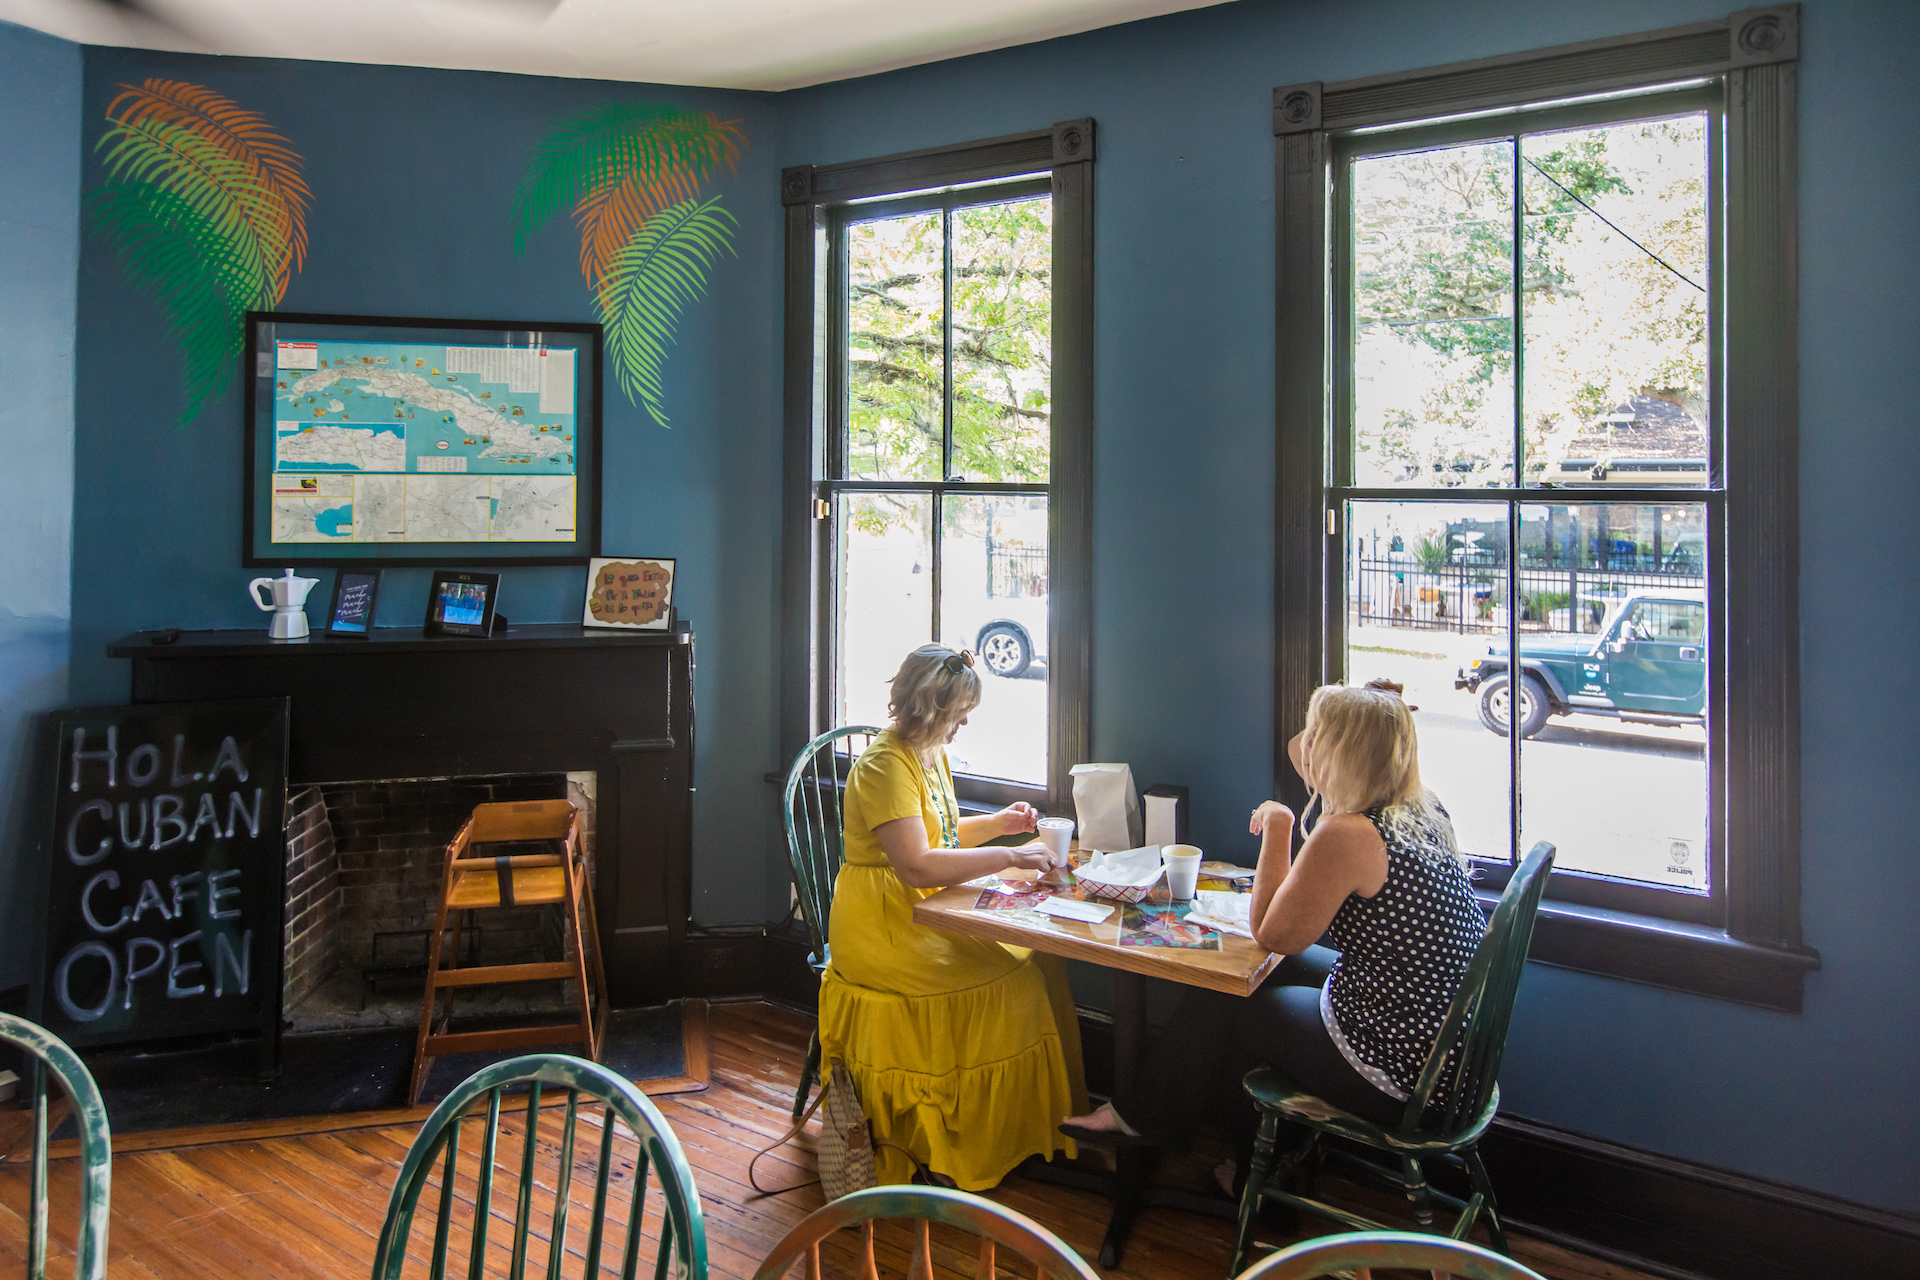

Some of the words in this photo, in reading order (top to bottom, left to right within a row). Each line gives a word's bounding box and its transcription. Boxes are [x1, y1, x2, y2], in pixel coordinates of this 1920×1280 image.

[67, 788, 262, 866] CUBAN
[81, 869, 242, 933] CAFE
[55, 929, 253, 1022] OPEN
